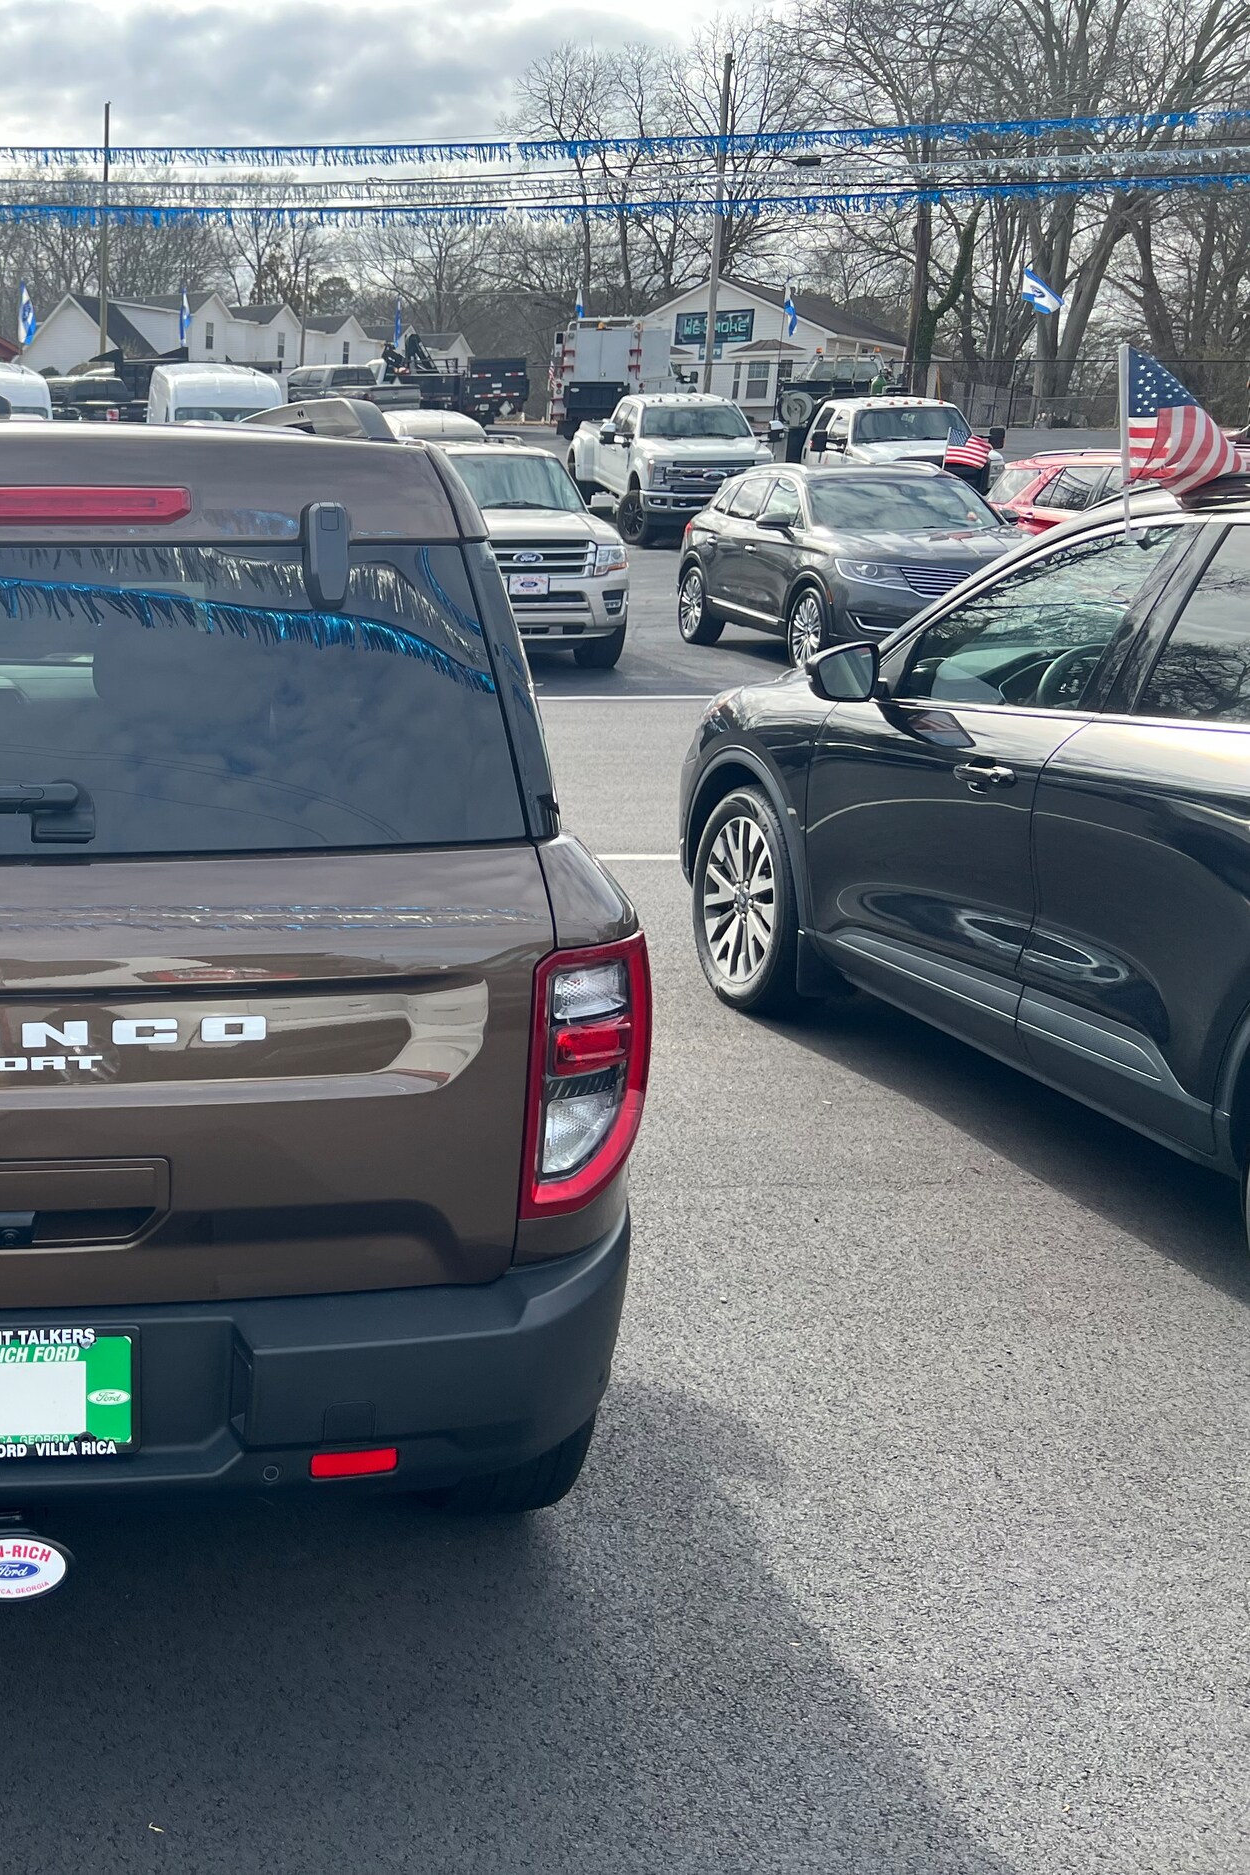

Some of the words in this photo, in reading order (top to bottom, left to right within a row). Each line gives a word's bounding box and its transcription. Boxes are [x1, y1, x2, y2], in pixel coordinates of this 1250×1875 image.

[18, 1328, 96, 1346] TALKERS
[33, 1346, 80, 1363] FORD
[95, 1391, 122, 1403] Ford
[36, 1442, 78, 1457] VILLA
[81, 1441, 117, 1455] RICA
[16, 1581, 50, 1594] GEORGIA
